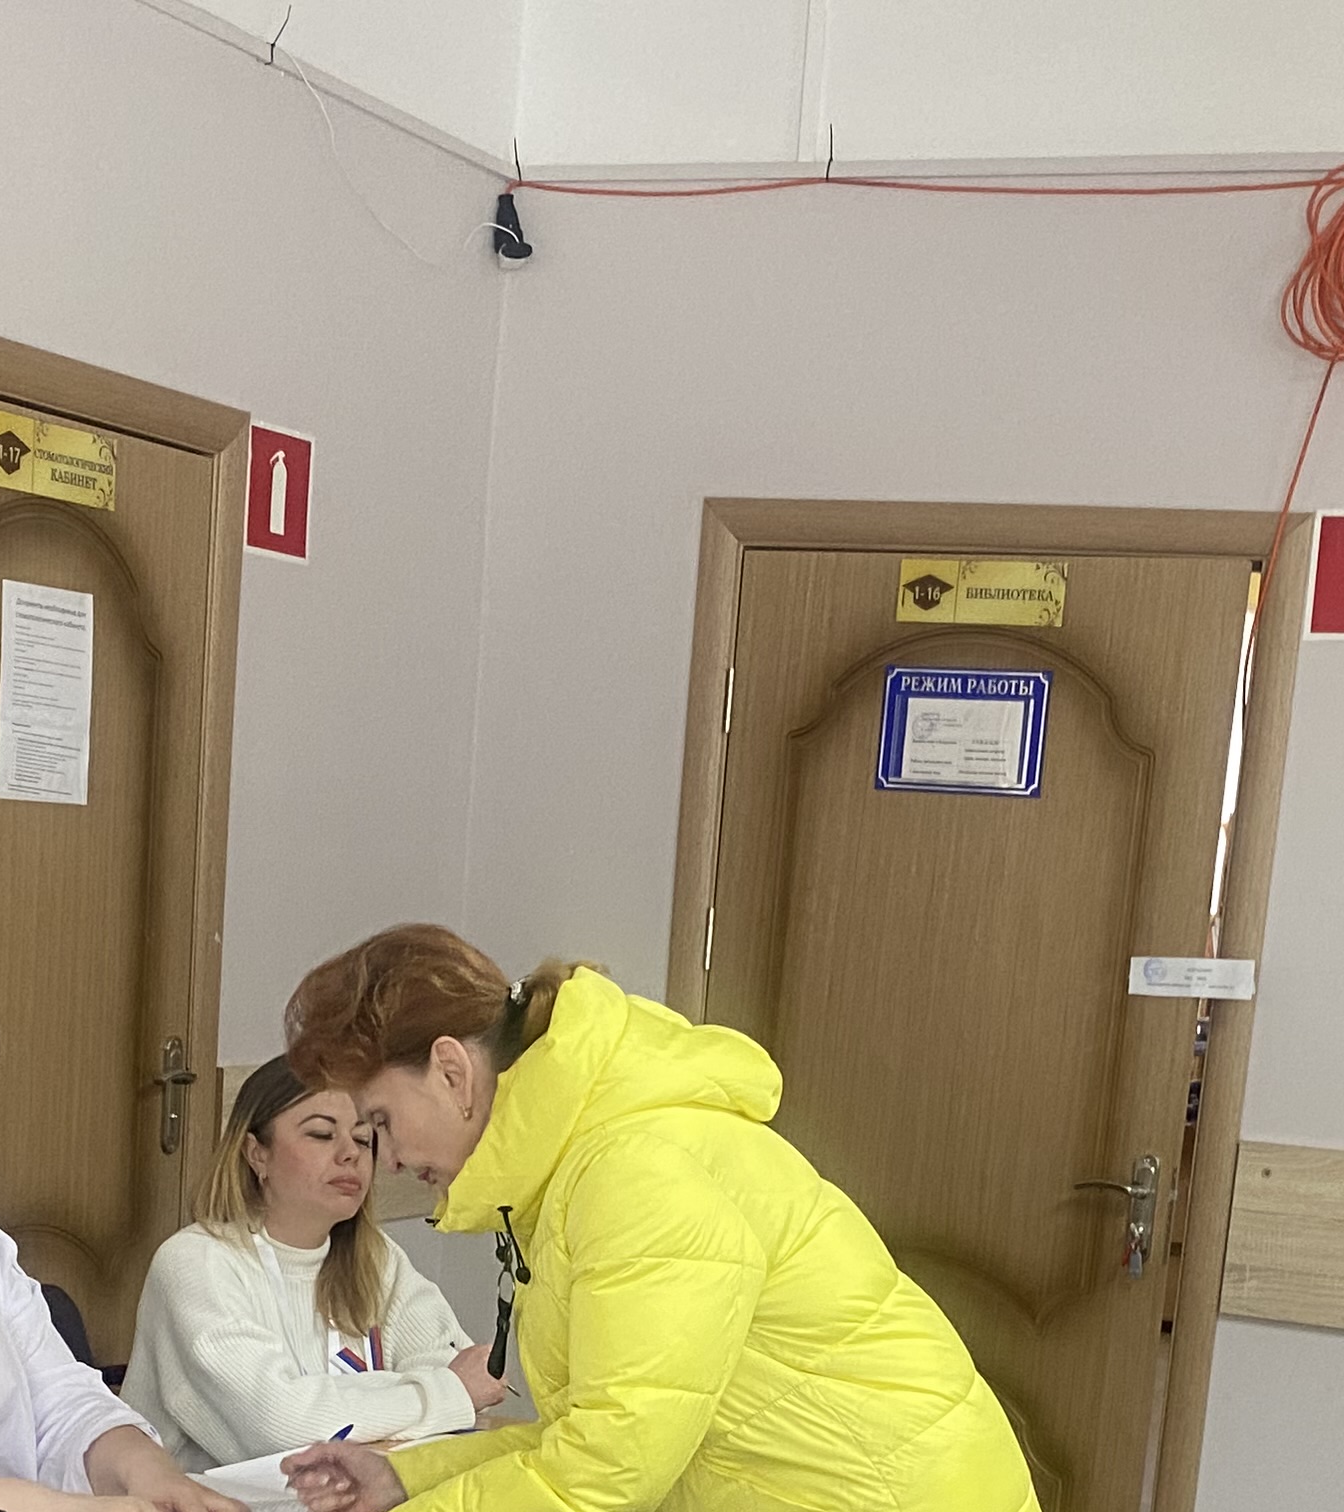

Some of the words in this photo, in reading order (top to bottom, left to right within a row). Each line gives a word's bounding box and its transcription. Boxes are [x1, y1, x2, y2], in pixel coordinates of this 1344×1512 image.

[34, 449, 114, 475] СТОМАТОЛОГИЧЕСКИЙ
[50, 468, 97, 490] КАБИНЕТ
[914, 585, 941, 600] 1-16
[966, 587, 1054, 601] БИБЛИОТЕКА
[900, 675, 963, 694] РЕЖИМ
[966, 678, 1034, 695] РАБОТЫ
